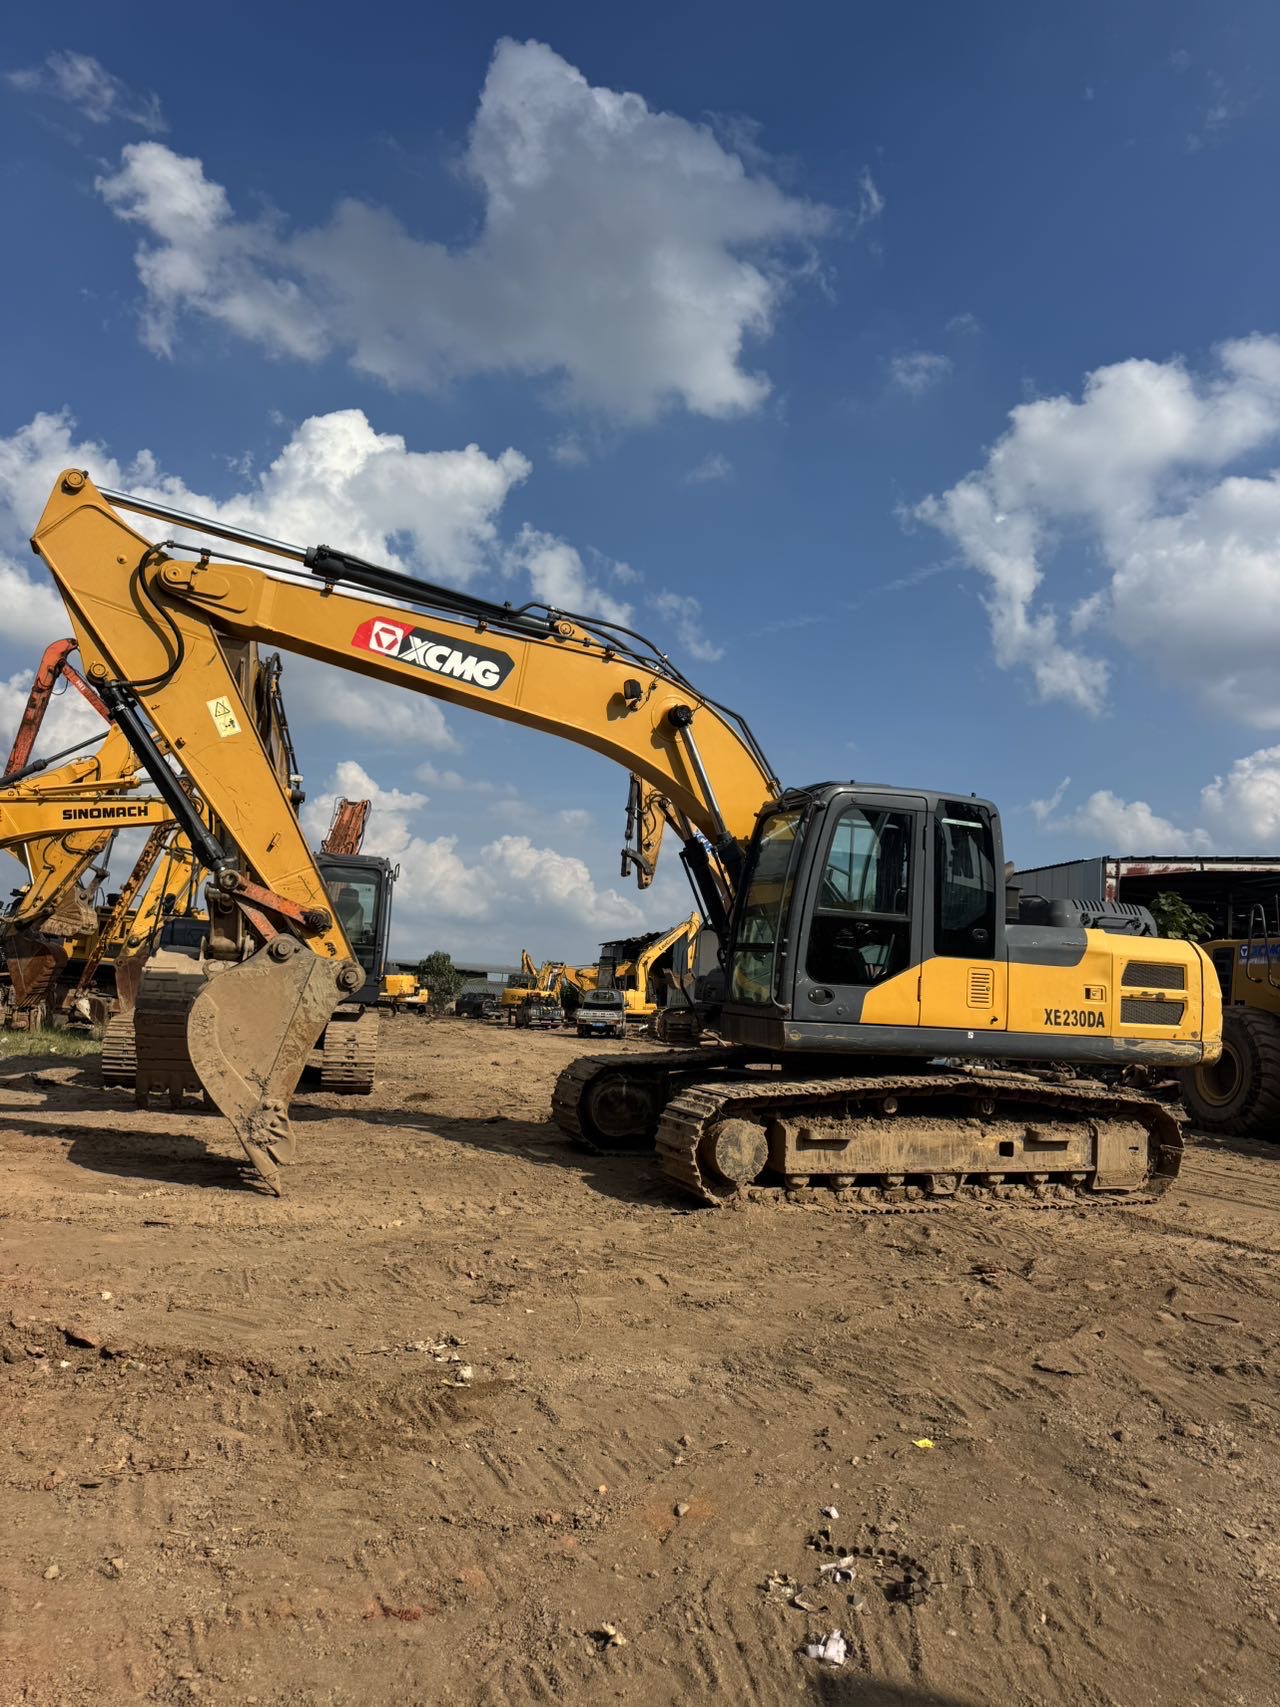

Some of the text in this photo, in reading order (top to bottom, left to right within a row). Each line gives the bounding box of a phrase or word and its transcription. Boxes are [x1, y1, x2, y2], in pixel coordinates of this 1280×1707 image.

[398, 635, 500, 687] XCMG
[62, 806, 148, 820] SINOMACH
[1044, 1008, 1105, 1028] XE230DA
